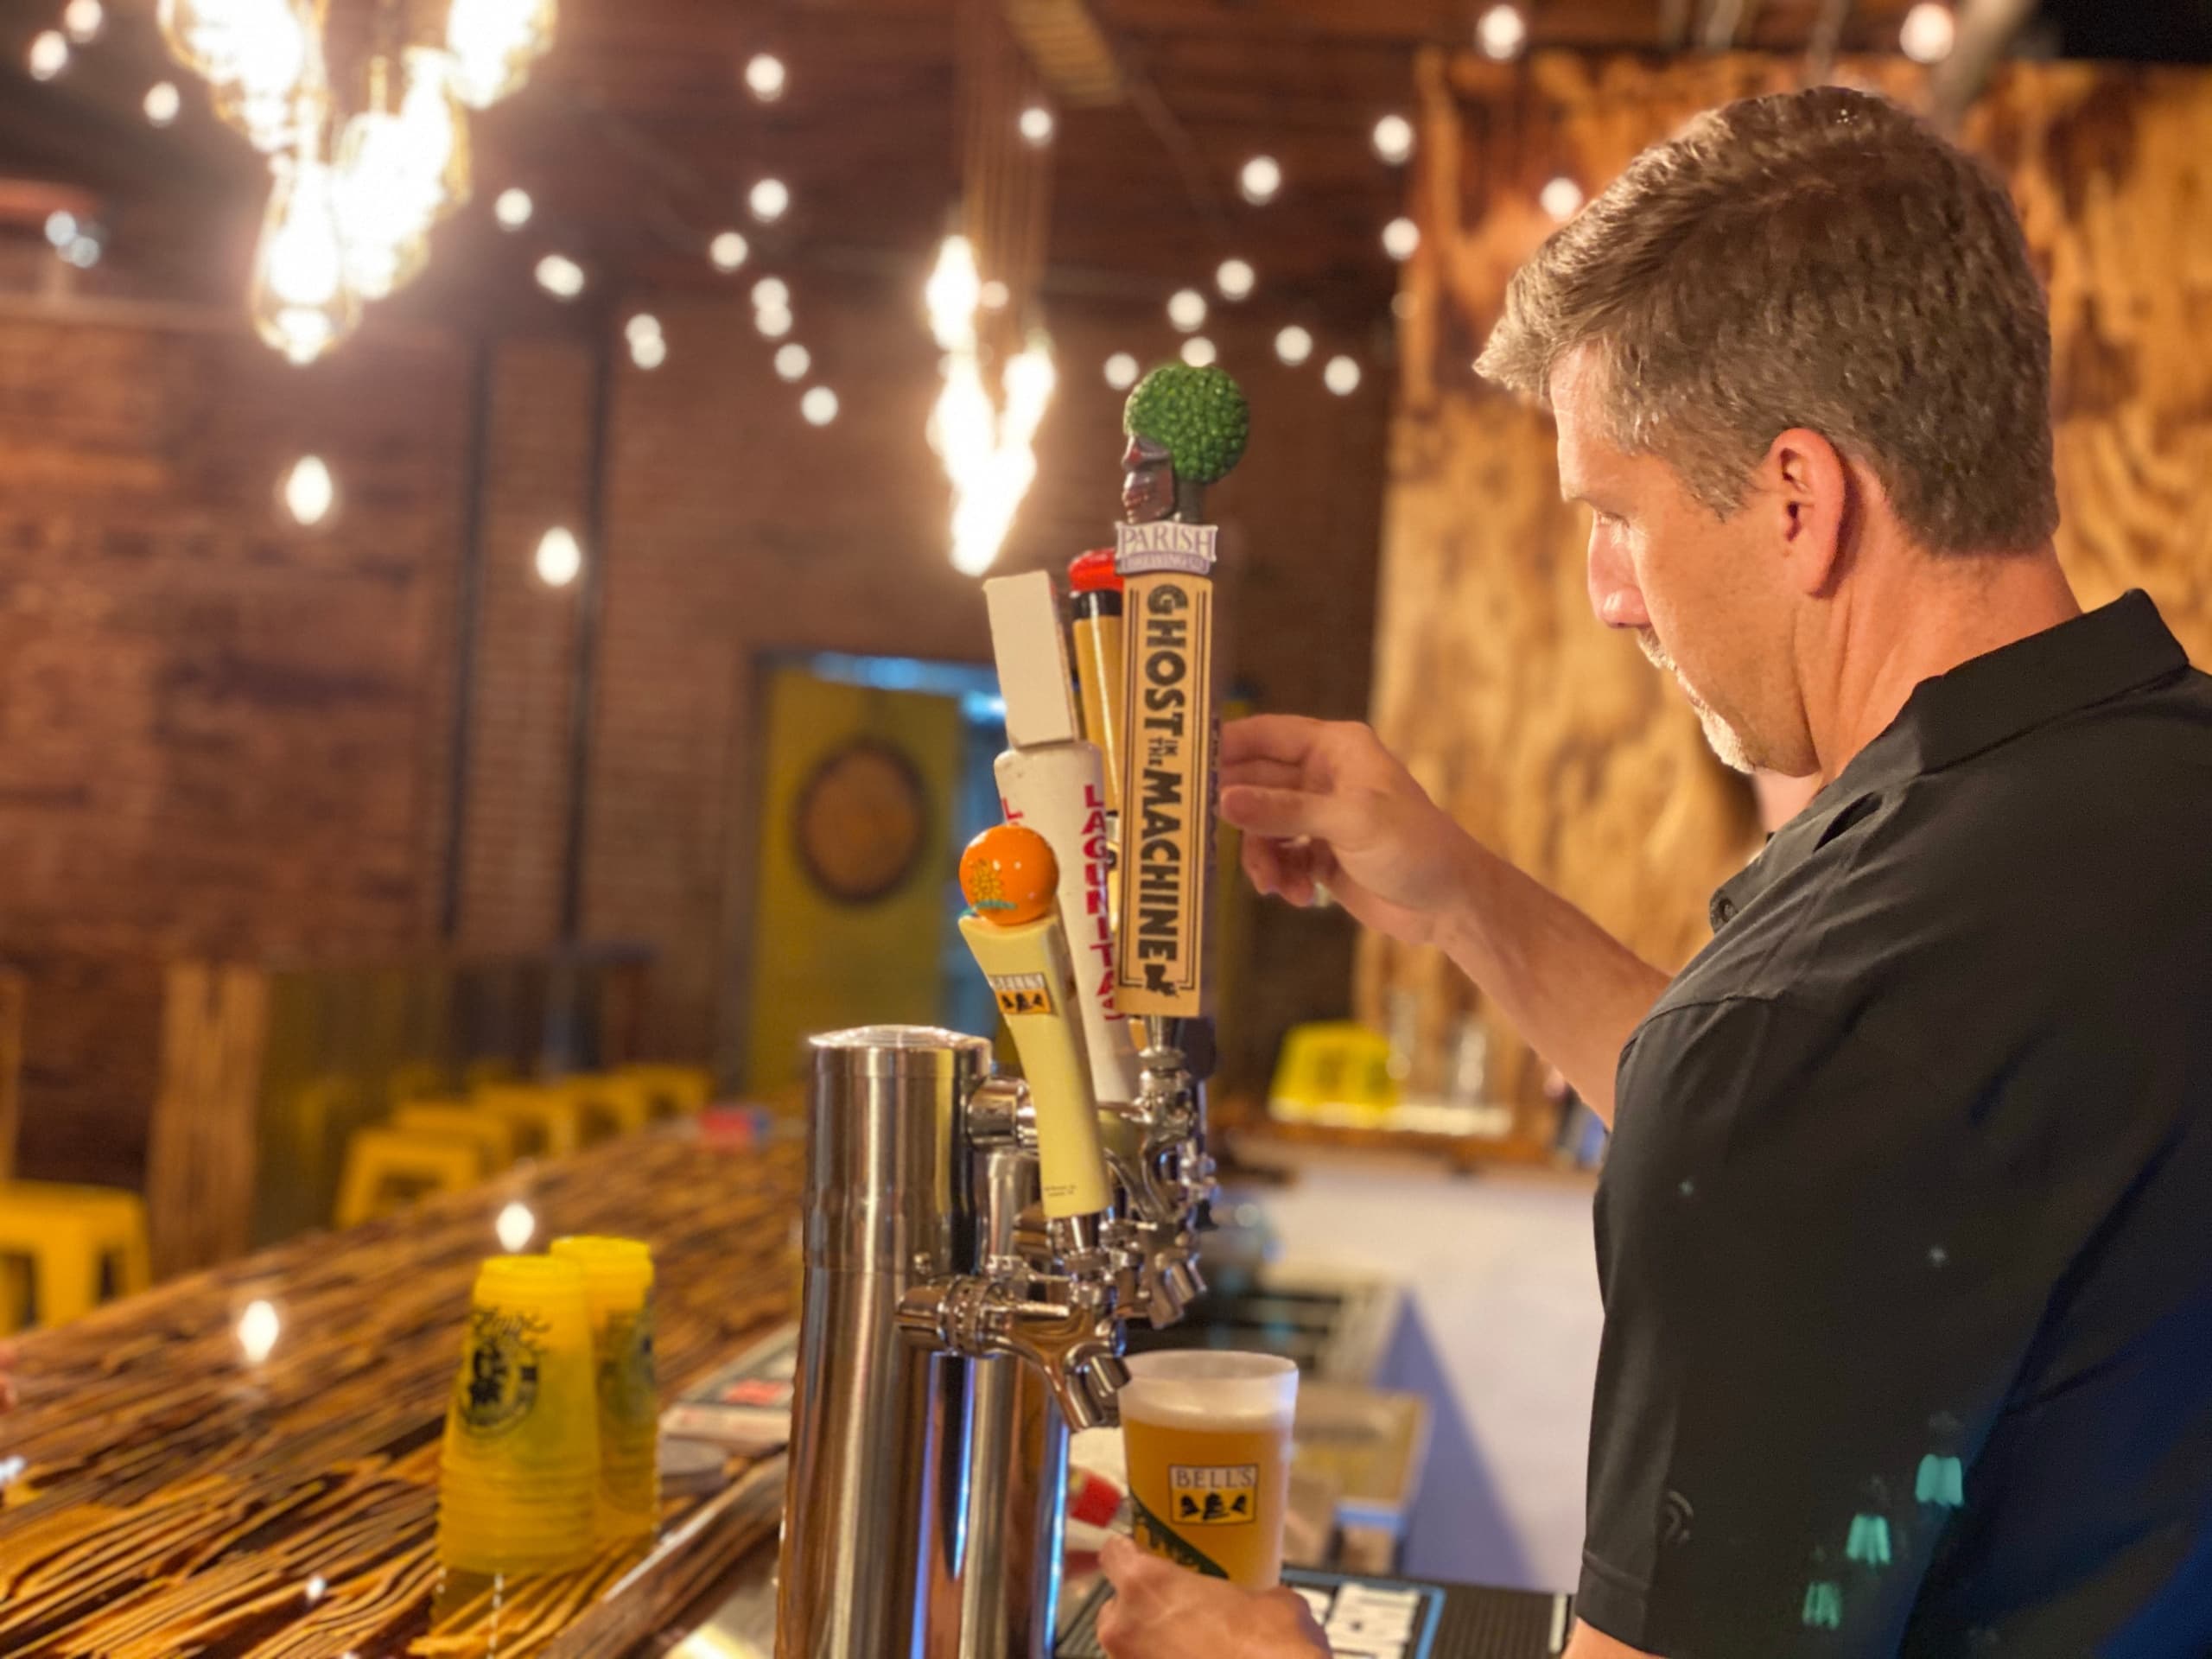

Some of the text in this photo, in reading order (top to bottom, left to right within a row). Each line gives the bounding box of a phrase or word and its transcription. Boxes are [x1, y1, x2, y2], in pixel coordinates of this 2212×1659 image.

[1121, 524, 1213, 557] PARISH
[1143, 583, 1189, 737] GHOST
[1138, 766, 1183, 962] MACHINE
